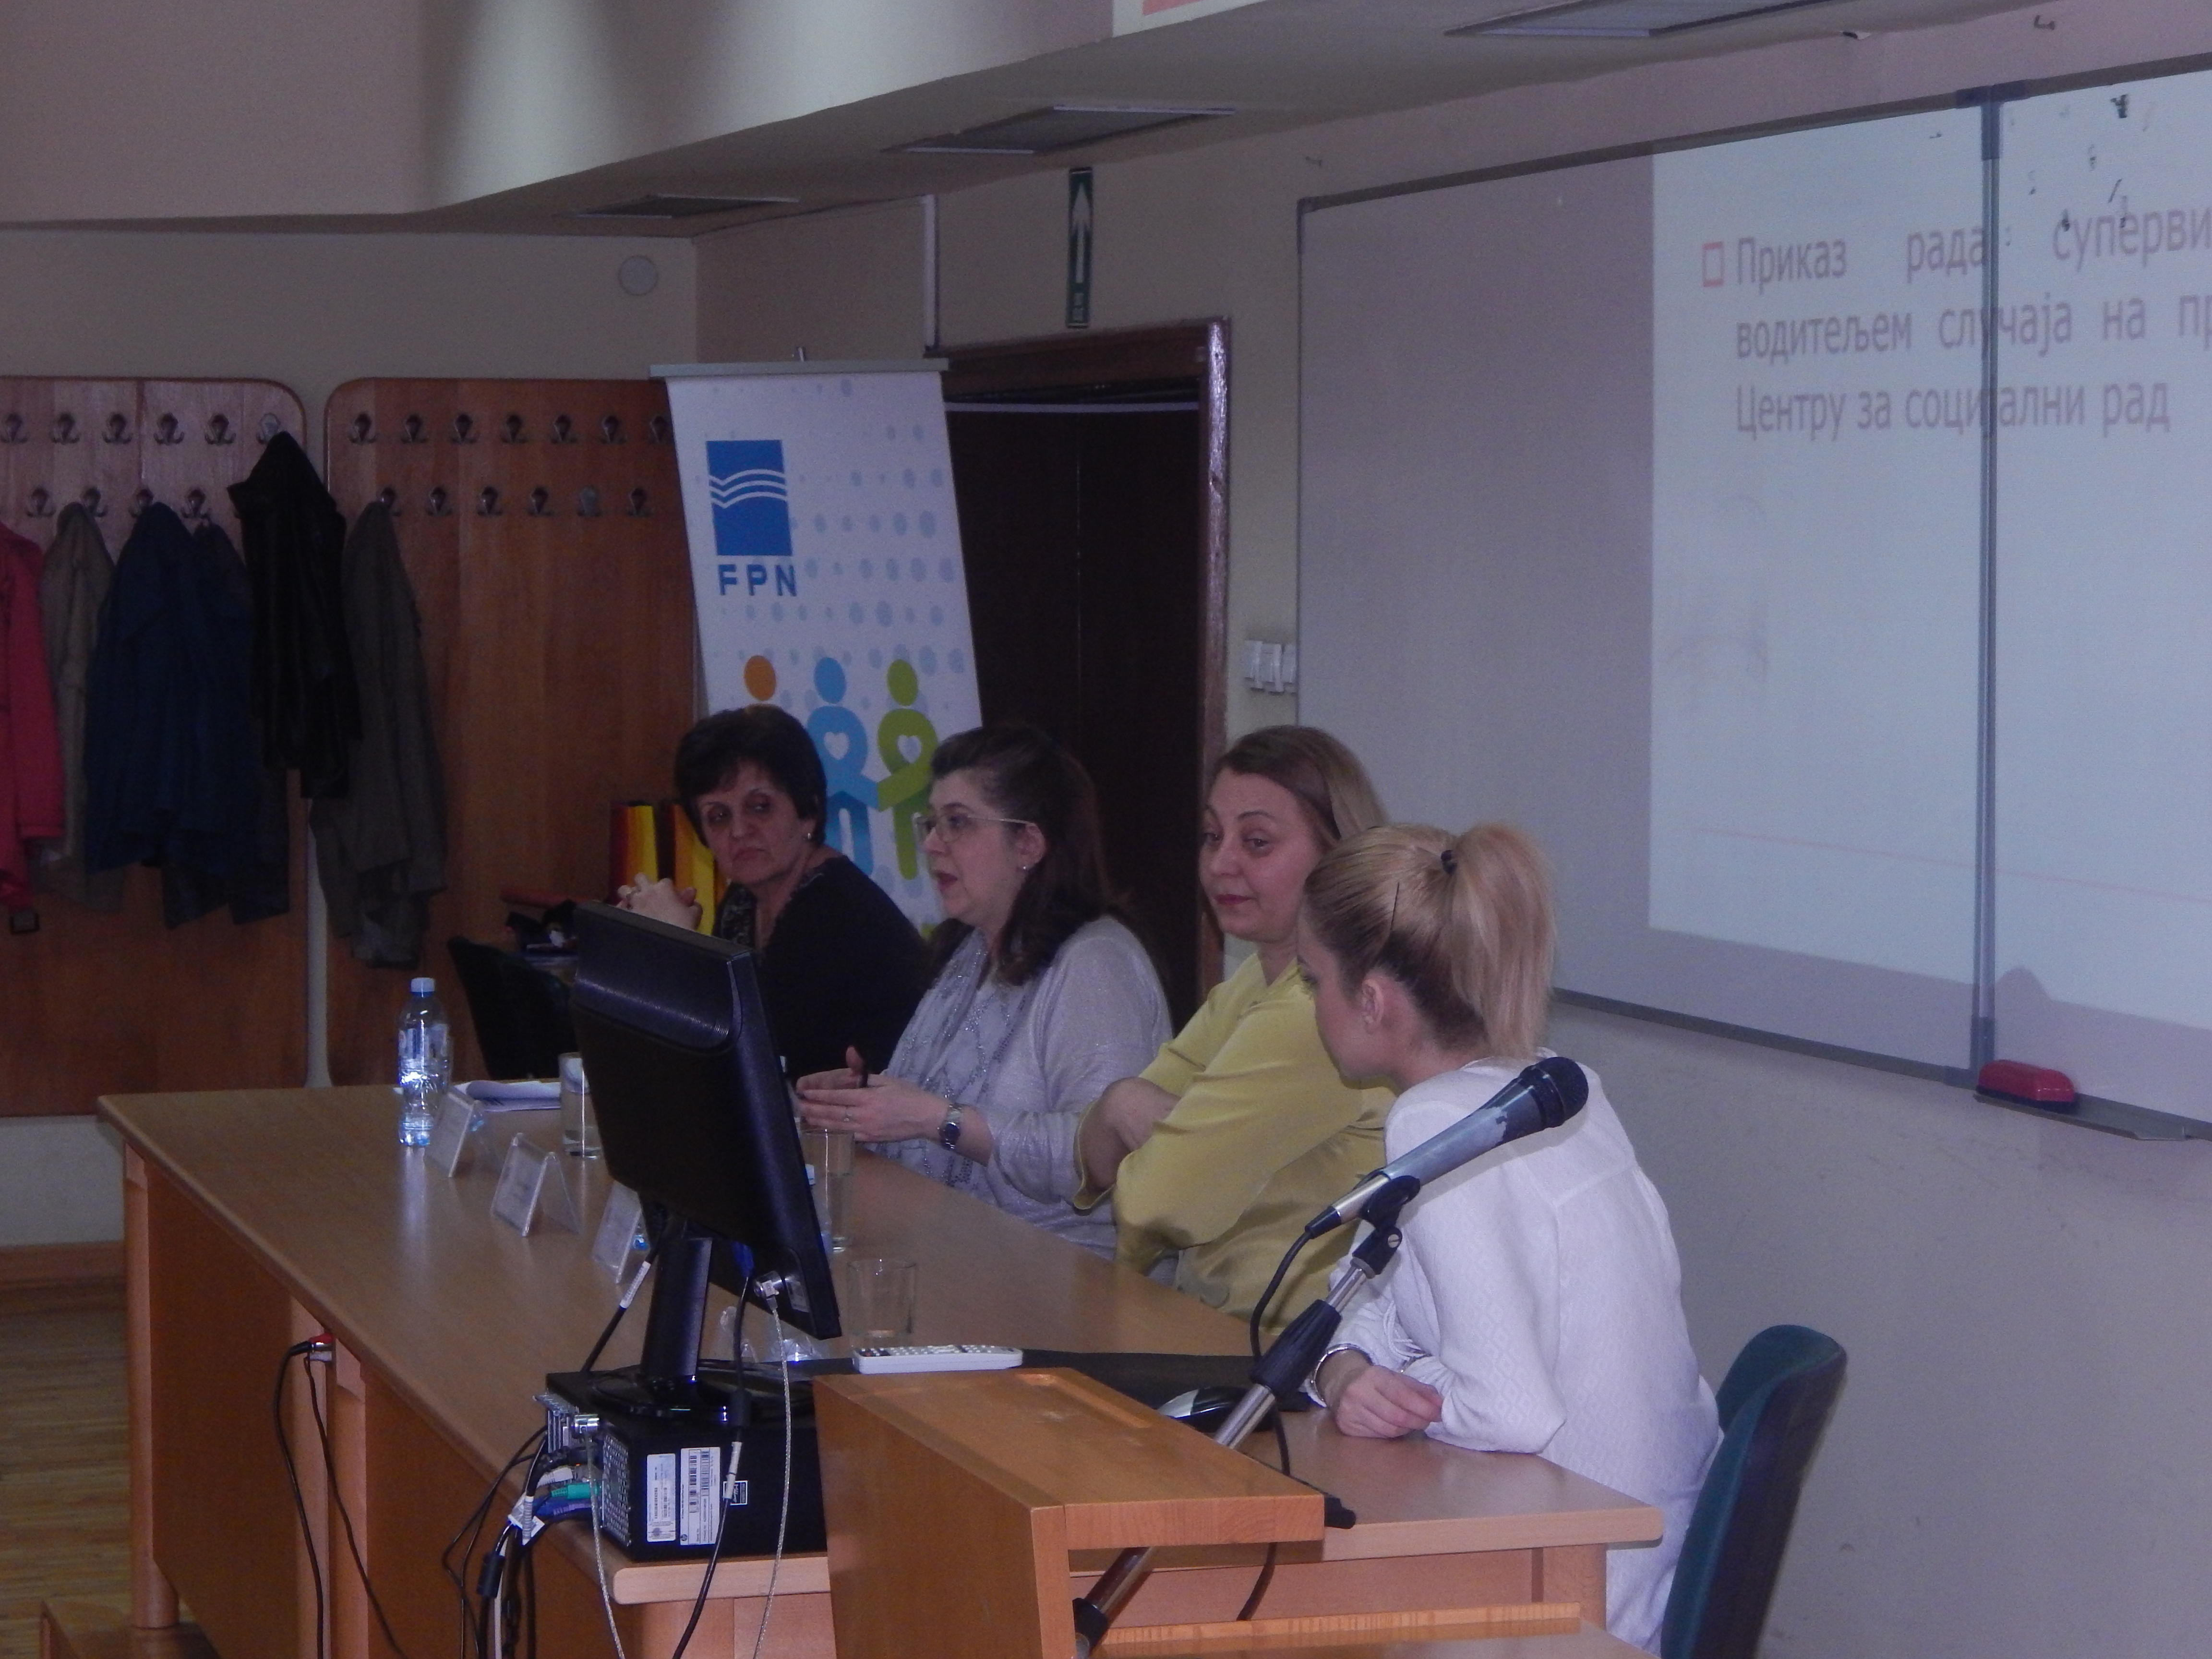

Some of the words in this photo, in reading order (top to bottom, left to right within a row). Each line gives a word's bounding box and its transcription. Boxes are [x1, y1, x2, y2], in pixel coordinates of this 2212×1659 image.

[1737, 236, 1847, 295] Приказ
[1906, 227, 1989, 284] рада
[1736, 312, 1912, 366] водитељем
[1938, 291, 2072, 358] слчаја
[2103, 298, 2146, 340] на
[1737, 385, 1847, 442] Центру
[1857, 390, 1891, 430] за
[1906, 386, 2085, 435] социални
[2103, 383, 2171, 438] рад
[718, 564, 797, 597] FPN
